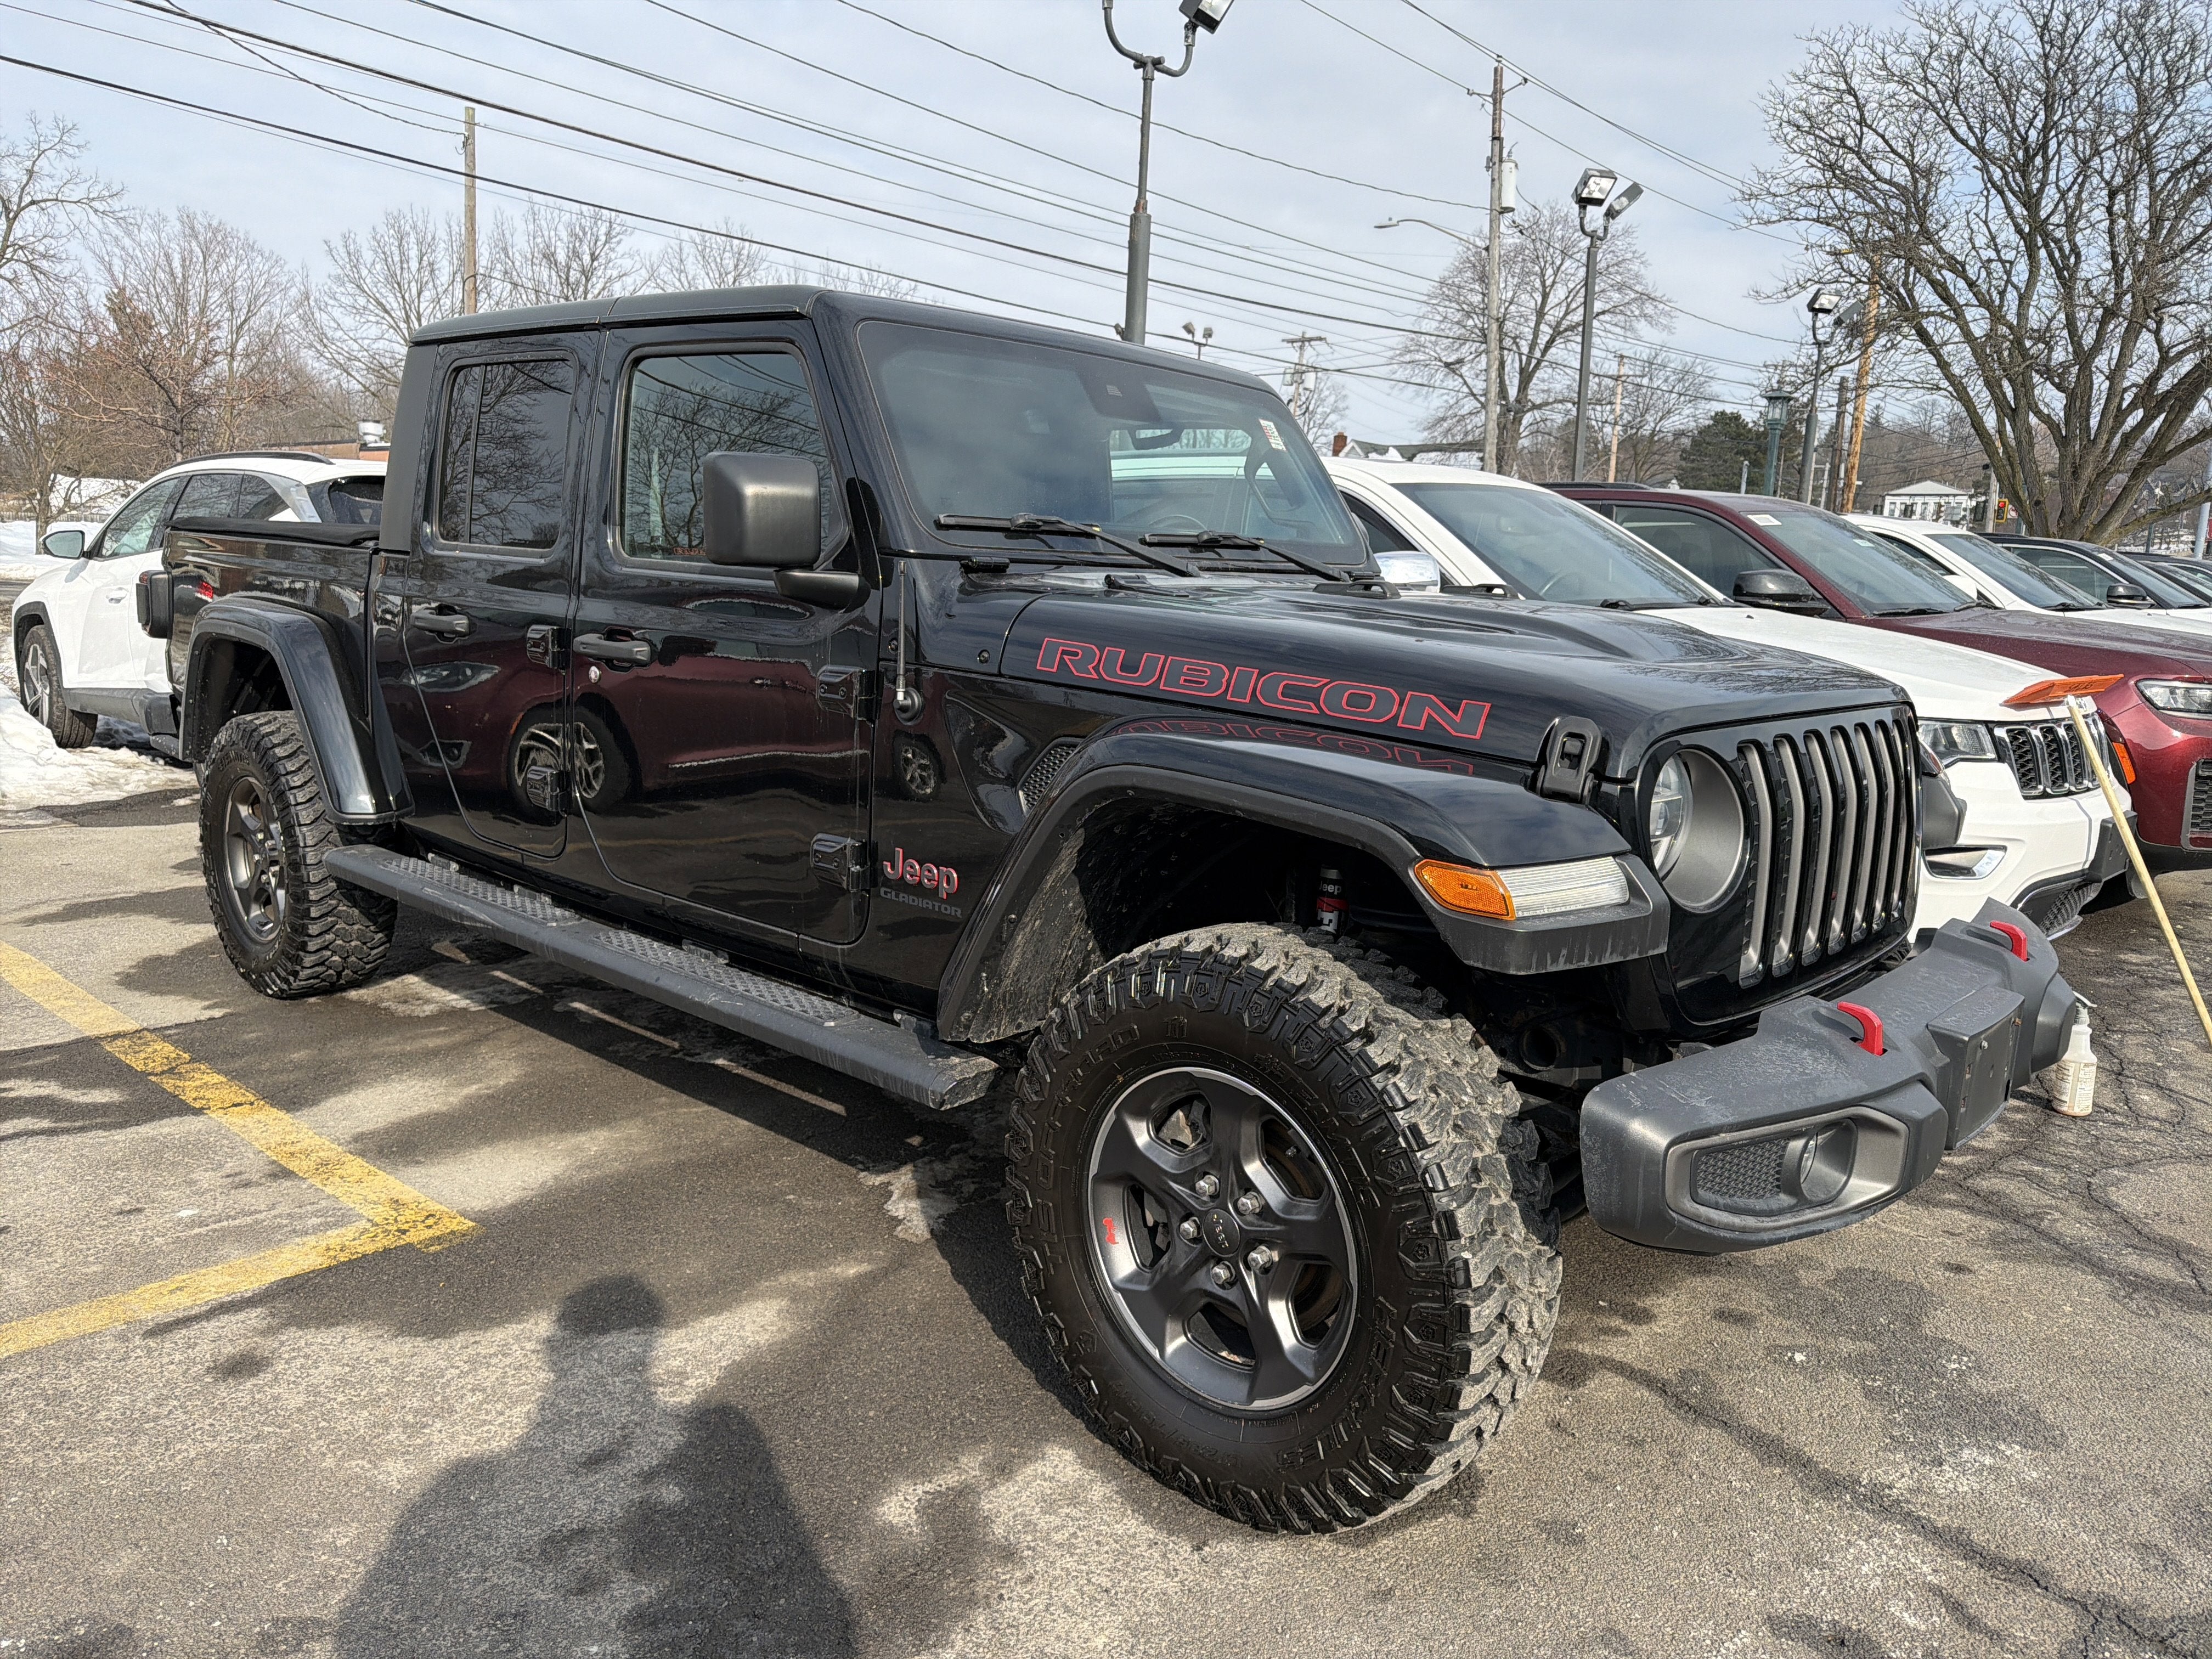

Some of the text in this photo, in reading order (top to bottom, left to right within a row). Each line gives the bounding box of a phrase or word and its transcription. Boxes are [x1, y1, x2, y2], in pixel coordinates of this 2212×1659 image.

[1036, 637, 1492, 740] RUBICON
[882, 847, 959, 900] Jeep
[1318, 880, 1342, 895] Jeep
[879, 887, 962, 918] GLADIATOR
